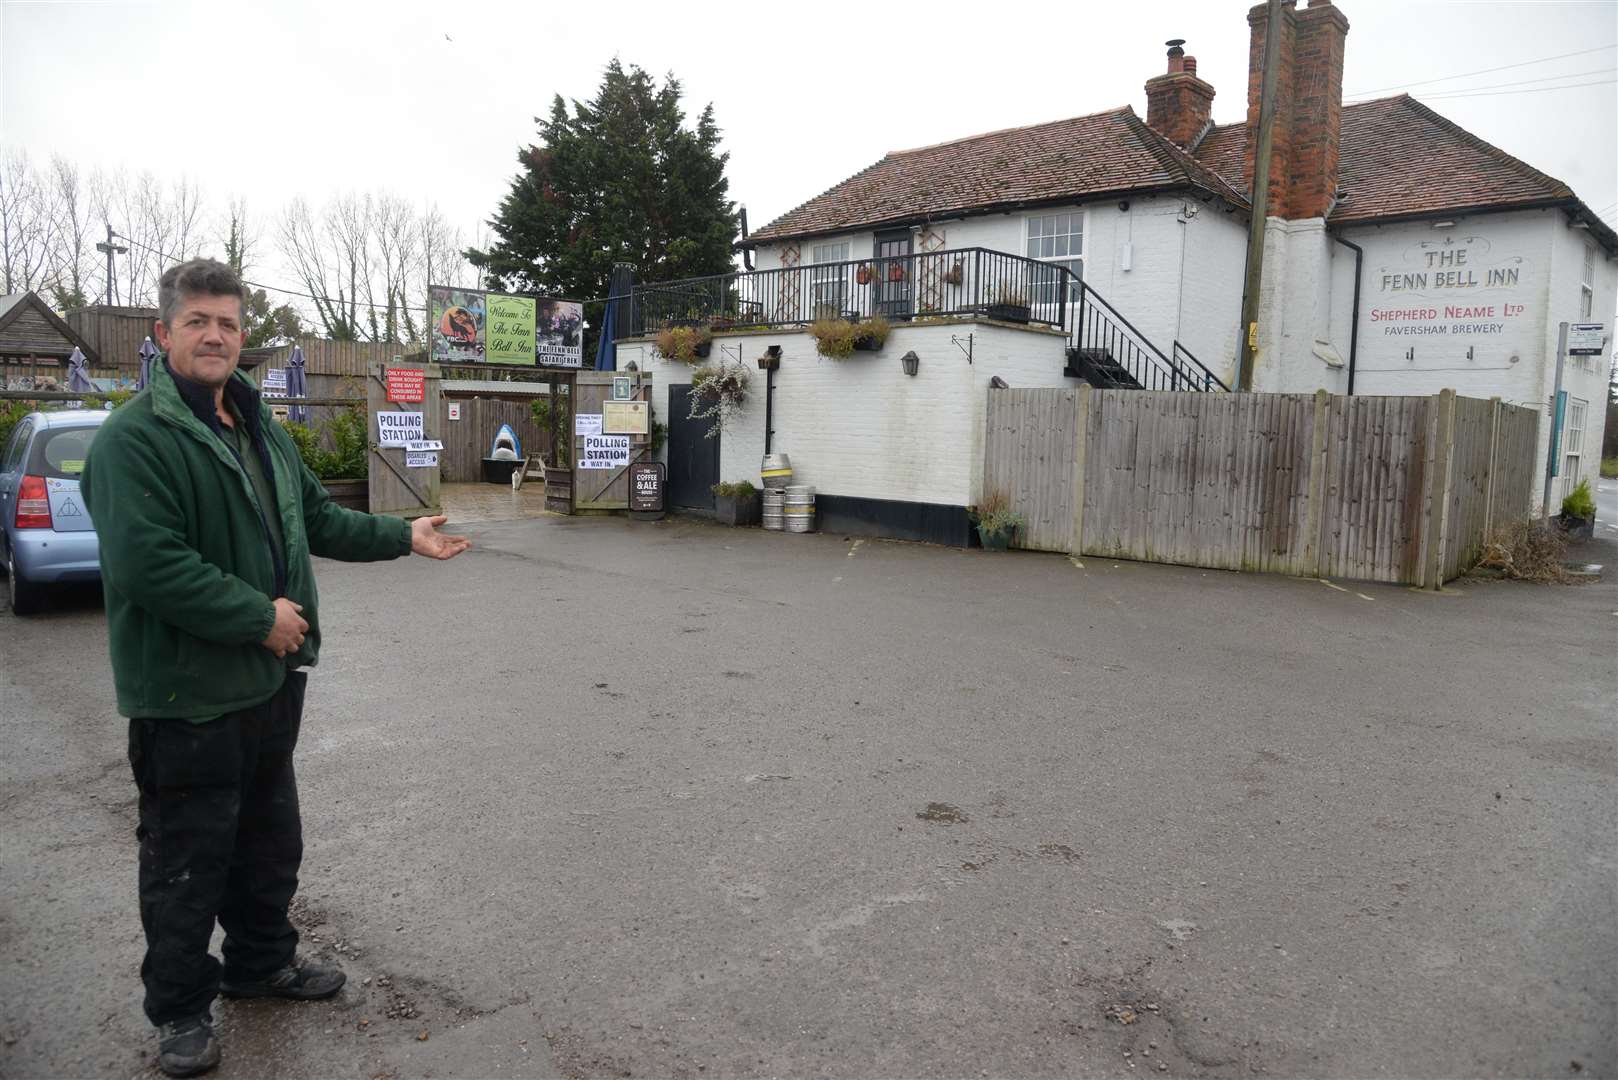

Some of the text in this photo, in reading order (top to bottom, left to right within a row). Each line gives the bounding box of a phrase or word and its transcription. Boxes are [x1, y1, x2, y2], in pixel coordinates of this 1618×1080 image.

[1425, 249, 1468, 268] THE
[1380, 267, 1520, 292] FENN BELL INN
[489, 306, 532, 320] Welcome To
[491, 322, 530, 336] The Fenn
[1384, 323, 1504, 336] FAVERSHAM BREWERY
[490, 339, 532, 353] Bell Inn
[539, 345, 580, 354] THE FENN BELL
[540, 355, 578, 364] SAFARI TREK
[380, 415, 421, 427] POLLING
[382, 429, 422, 441] STATION
[586, 438, 627, 448] POLLING
[587, 450, 627, 460] STATION
